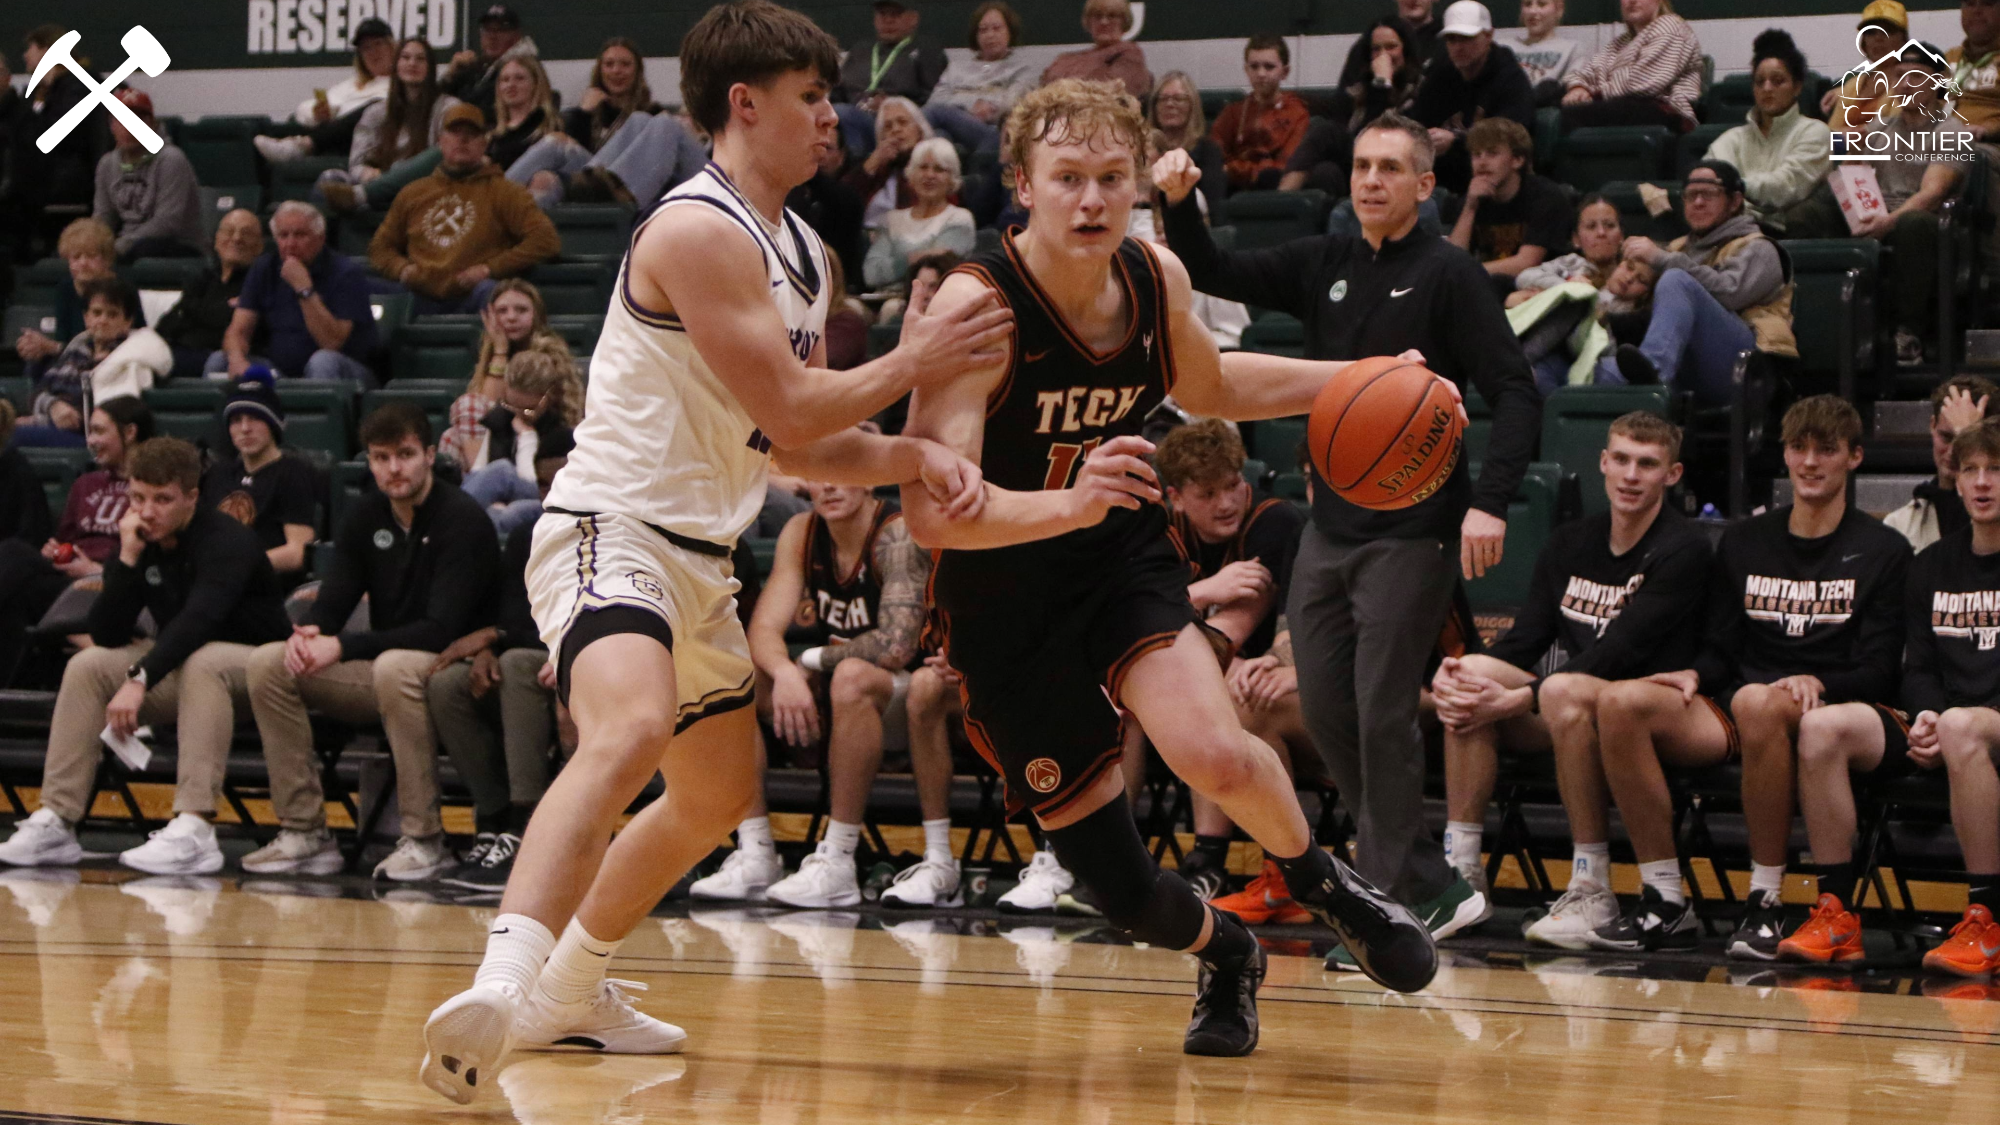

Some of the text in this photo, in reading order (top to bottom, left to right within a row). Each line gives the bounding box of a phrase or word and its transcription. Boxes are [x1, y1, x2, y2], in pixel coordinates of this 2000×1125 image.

[247, 0, 456, 53] RESERVED
[1034, 384, 1147, 433] TECH
[1377, 405, 1451, 495] SPALDING
[1744, 595, 1853, 614] BASKETBALL
[1746, 574, 1856, 601] MONTANA TECH
